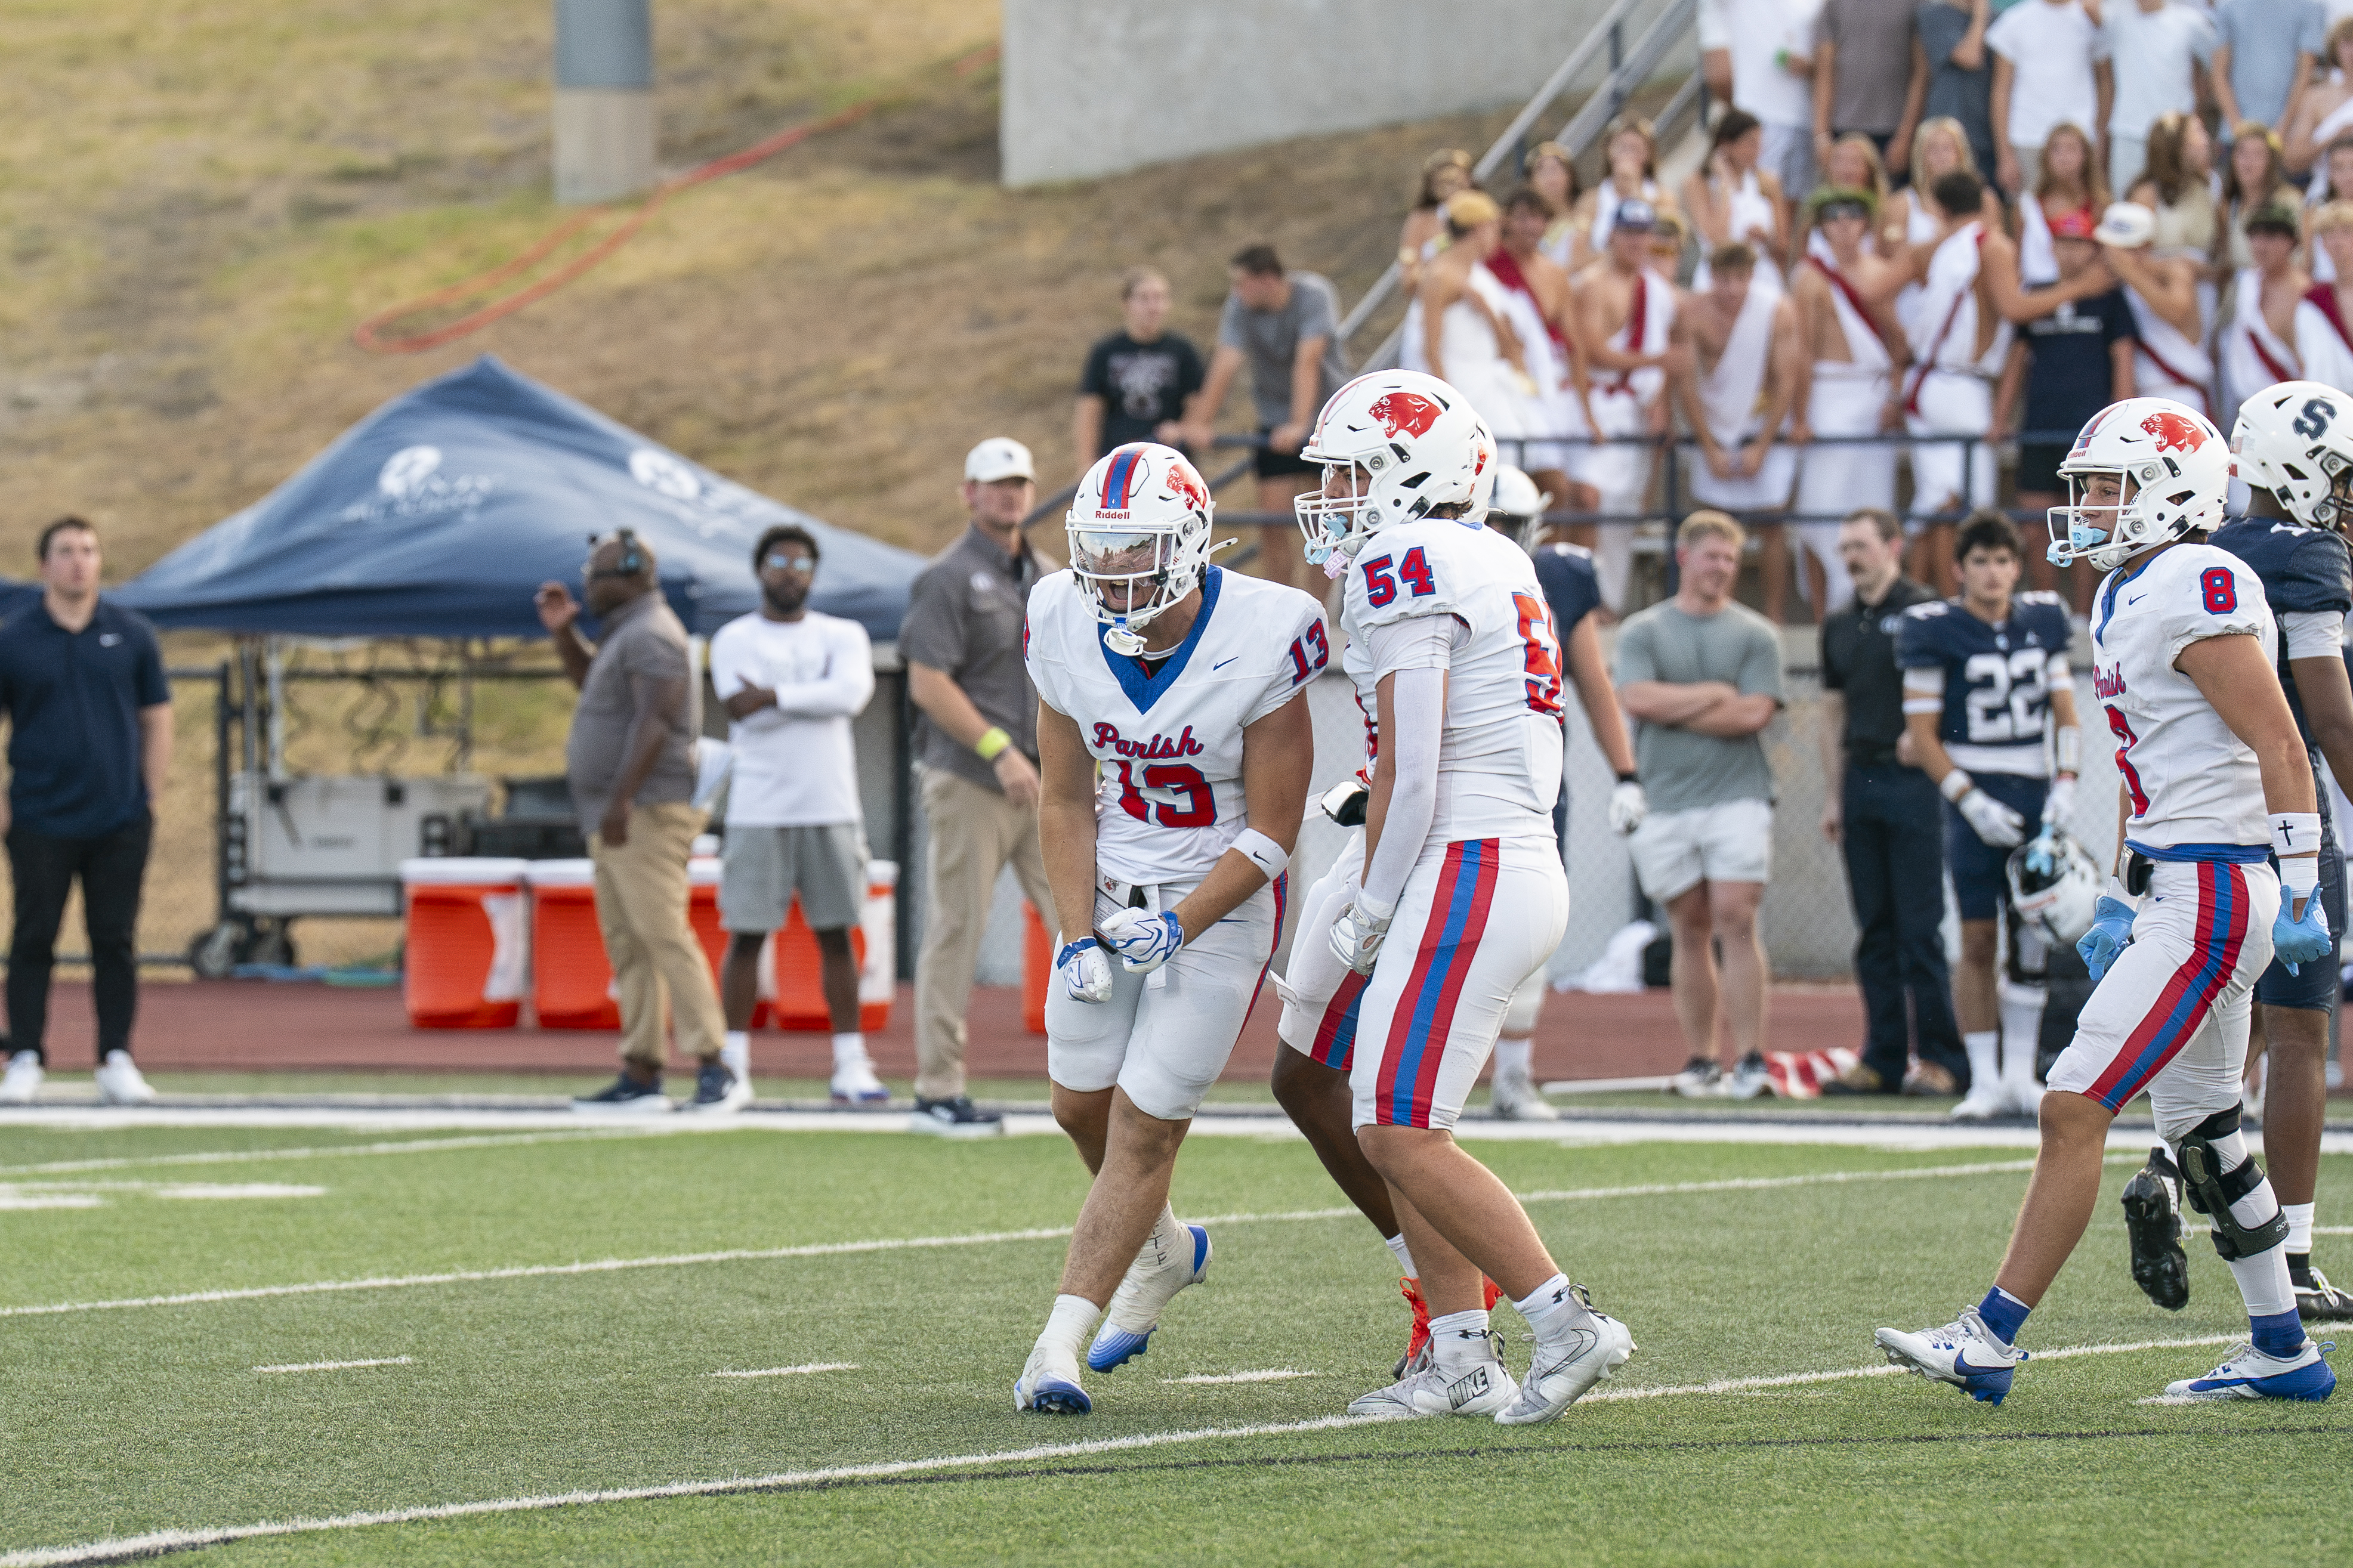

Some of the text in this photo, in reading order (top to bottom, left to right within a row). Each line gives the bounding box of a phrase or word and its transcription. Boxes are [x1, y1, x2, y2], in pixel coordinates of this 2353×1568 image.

[2292, 398, 2337, 441] S
[1095, 511, 1130, 519] Riddell
[1360, 546, 1436, 609] 54
[2200, 567, 2238, 615] 8
[1289, 617, 1329, 686] 13
[1511, 592, 1566, 725] 5
[1966, 647, 2048, 743] 22
[1092, 722, 1205, 759] Parish
[1108, 758, 1218, 827] 13
[1447, 1366, 1489, 1411] NIKE
